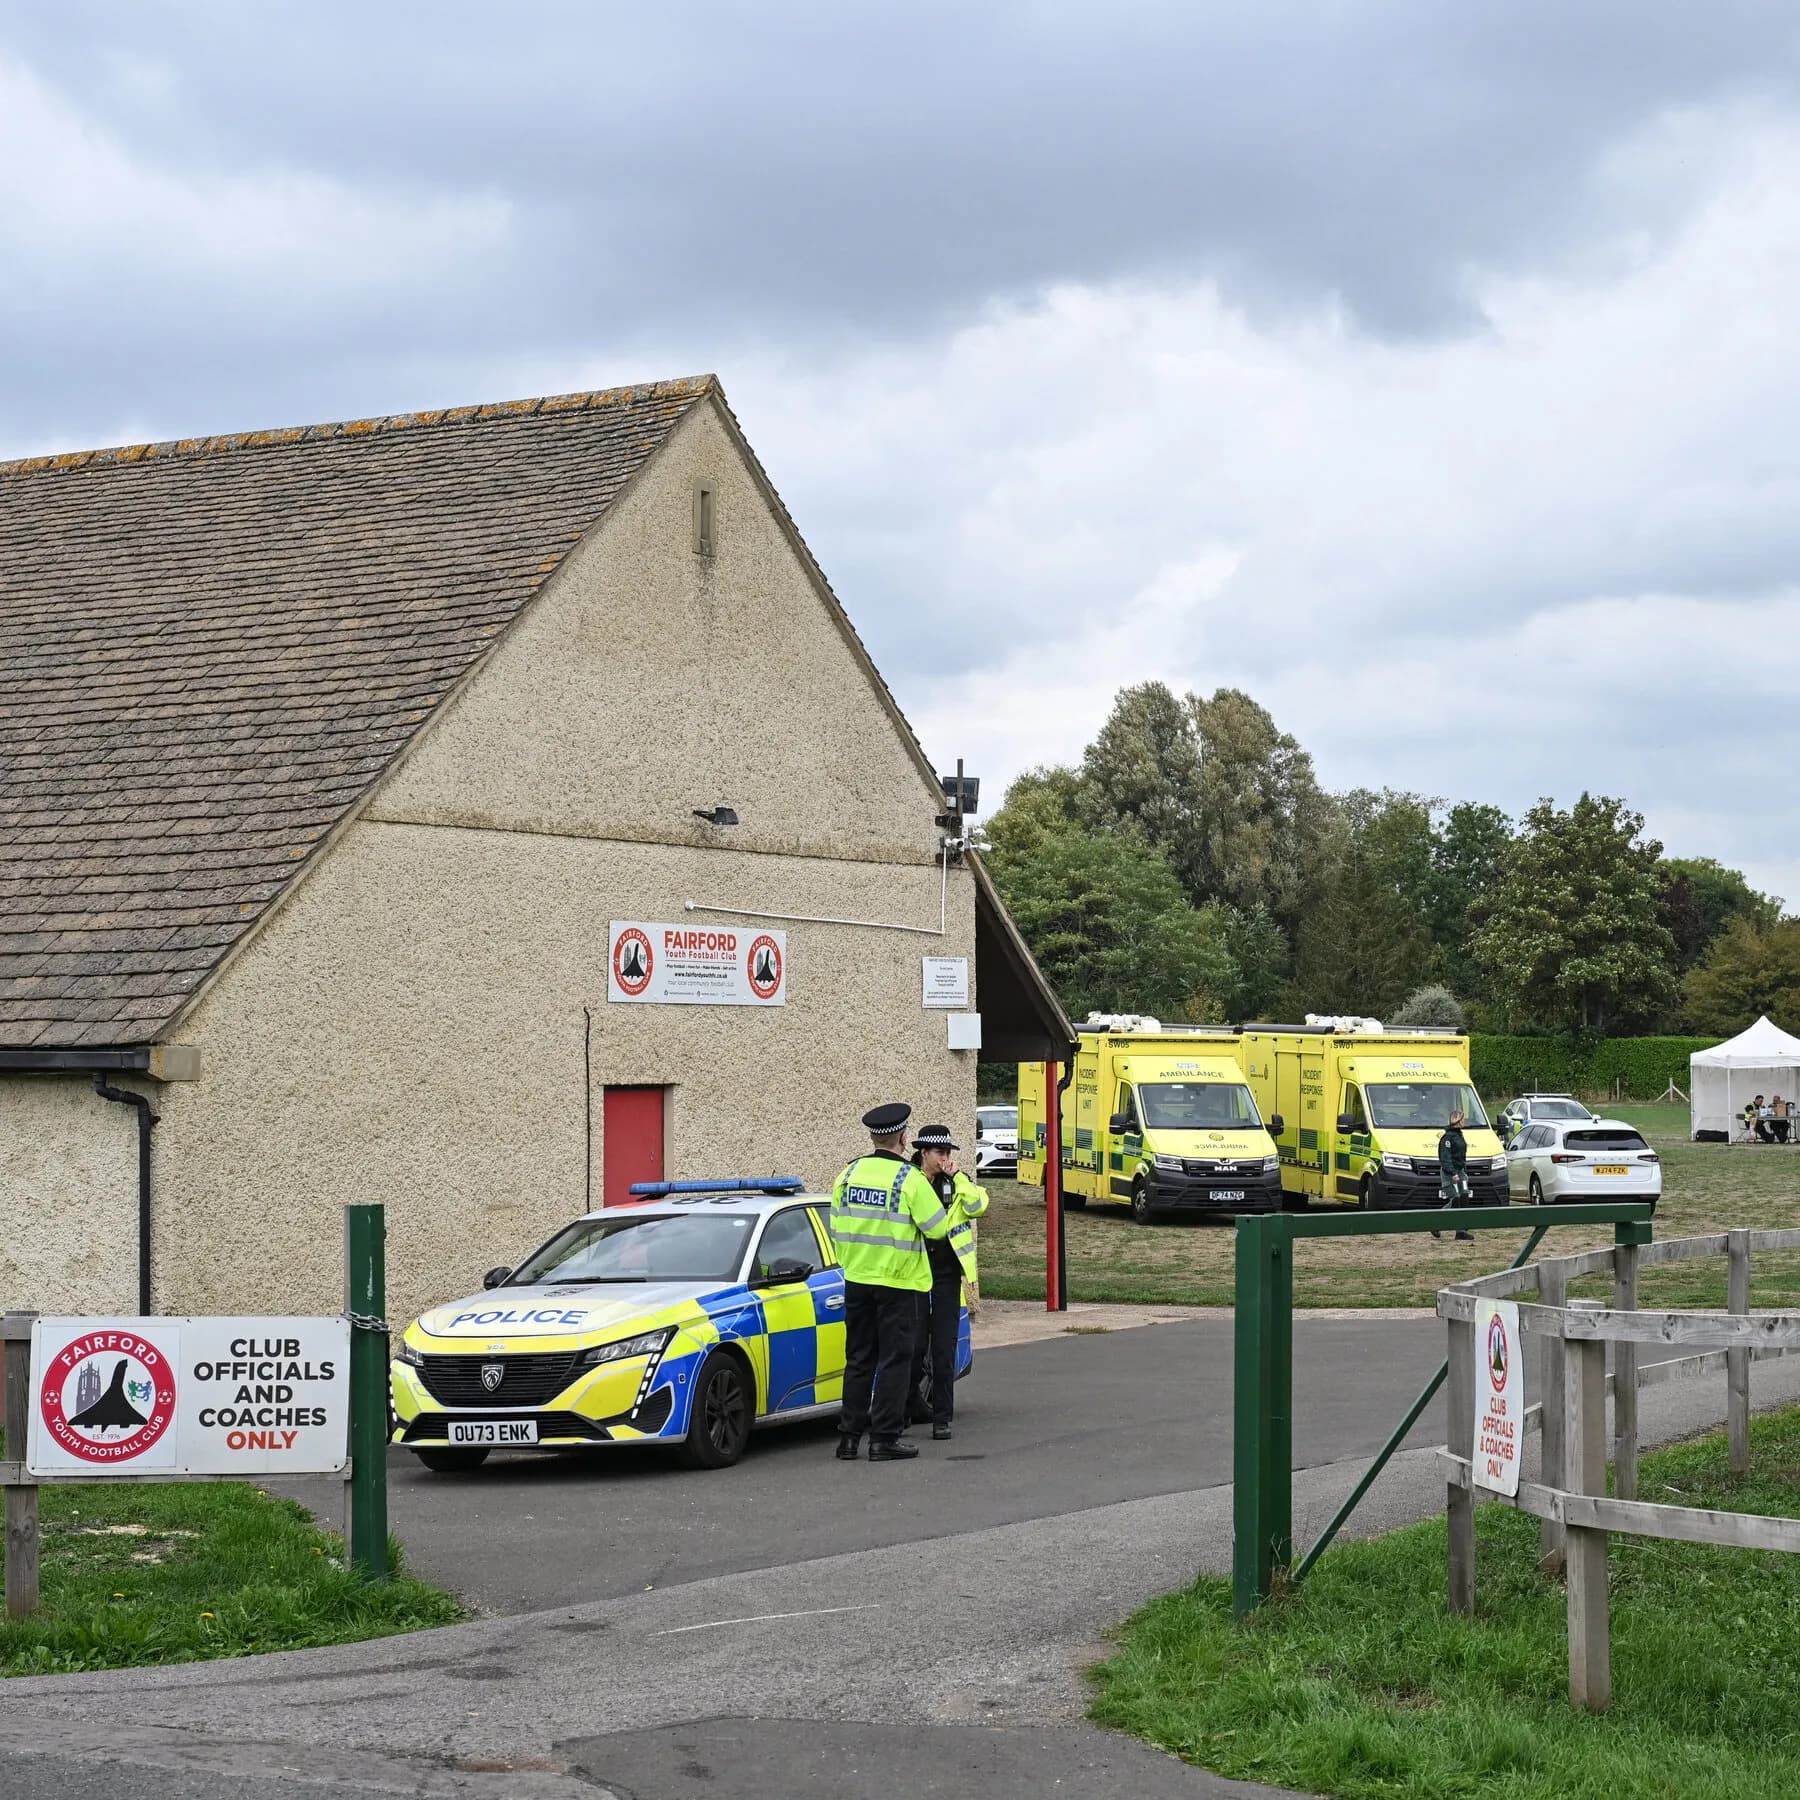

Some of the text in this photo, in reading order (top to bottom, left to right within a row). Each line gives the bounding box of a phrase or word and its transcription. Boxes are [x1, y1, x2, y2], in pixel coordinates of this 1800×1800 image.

[664, 930, 737, 951] FAIRFORD
[665, 950, 737, 960] Youth Football Club
[1159, 1070, 1225, 1079] AMBULANCE
[1385, 1070, 1451, 1079] AMBULANCE
[849, 1188, 886, 1205] POLICE
[448, 1310, 589, 1328] POLICE
[60, 1335, 158, 1367] FAIRFORD
[230, 1338, 301, 1358] CLUB
[193, 1361, 335, 1381] OFFICIALS
[233, 1385, 293, 1404] AND
[1490, 1396, 1507, 1416] CLUB
[198, 1407, 327, 1427] COACHES
[1482, 1415, 1514, 1439] OFFICIALS
[51, 1415, 164, 1457] YOUTH FOOTBALL CLUB
[226, 1430, 299, 1450] ONLY
[455, 1423, 530, 1442] OU73 ENK
[1480, 1435, 1514, 1461] & COACHES
